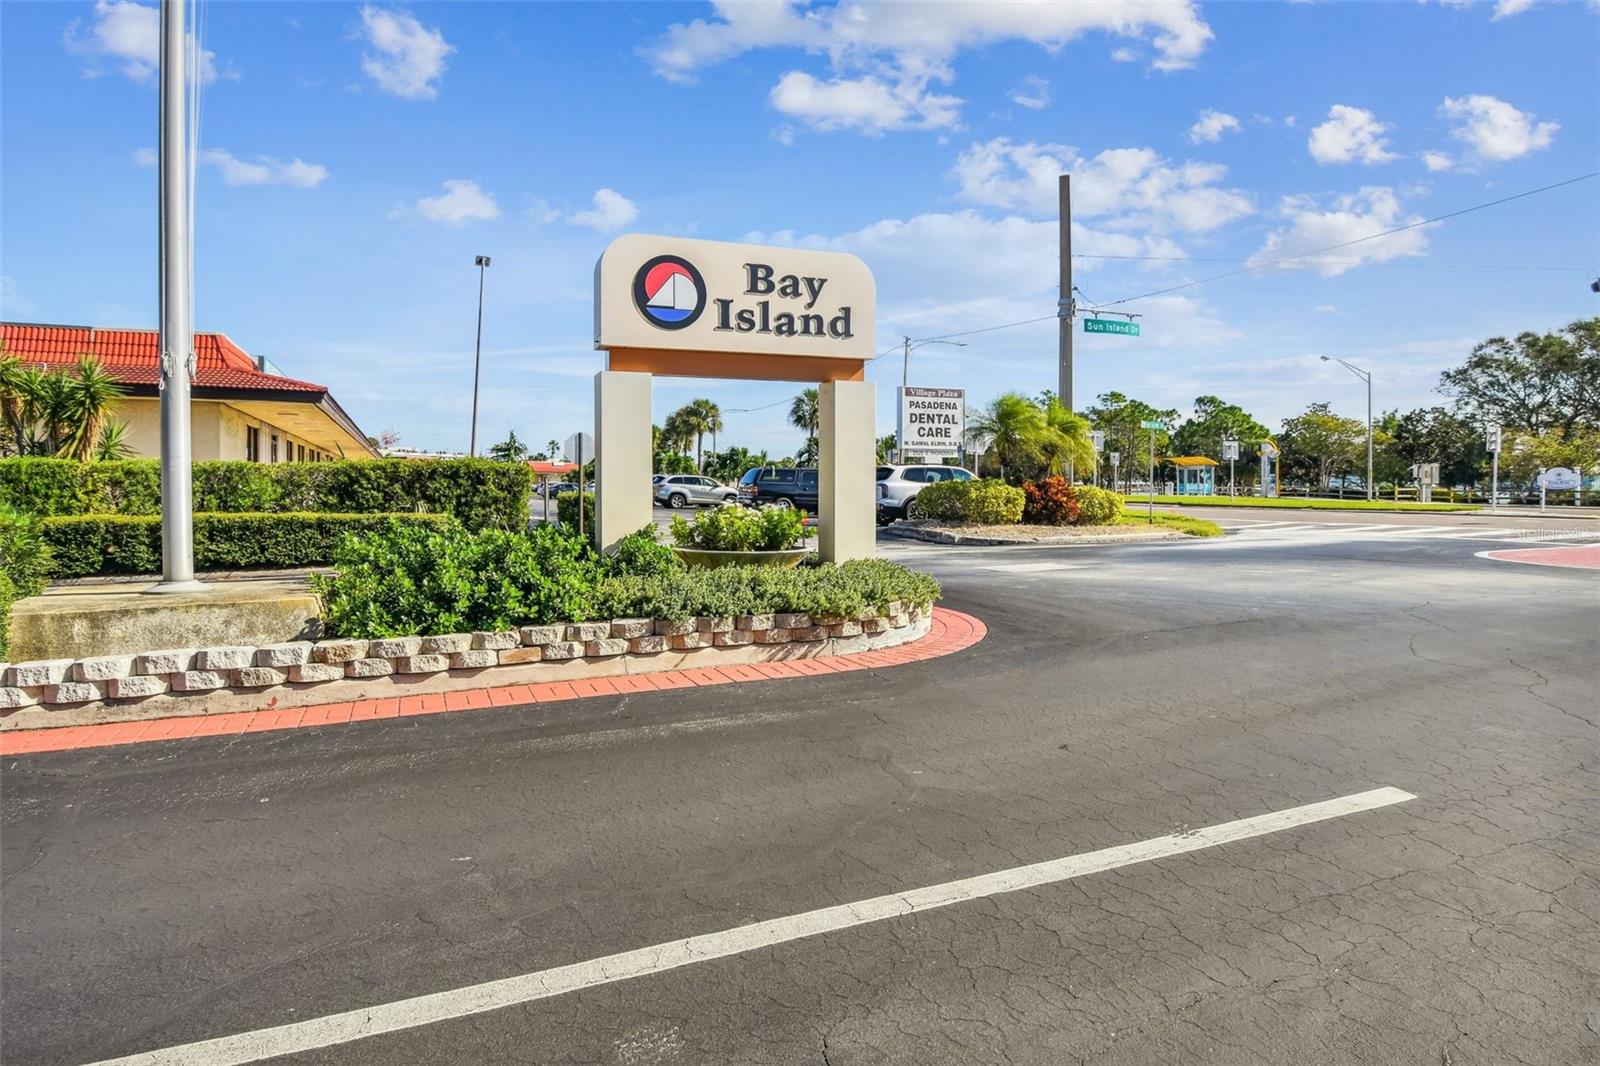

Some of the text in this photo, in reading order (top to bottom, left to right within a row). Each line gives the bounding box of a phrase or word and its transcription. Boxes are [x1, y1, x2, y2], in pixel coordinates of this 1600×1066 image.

[743, 262, 828, 310] Bay
[713, 298, 854, 340] Island
[1087, 322, 1104, 330] Sun
[1106, 323, 1129, 333] Island
[910, 388, 958, 397] Village Plaza
[909, 401, 958, 410] PASADENA
[910, 413, 958, 425] DENTAL
[917, 426, 951, 438] CARE
